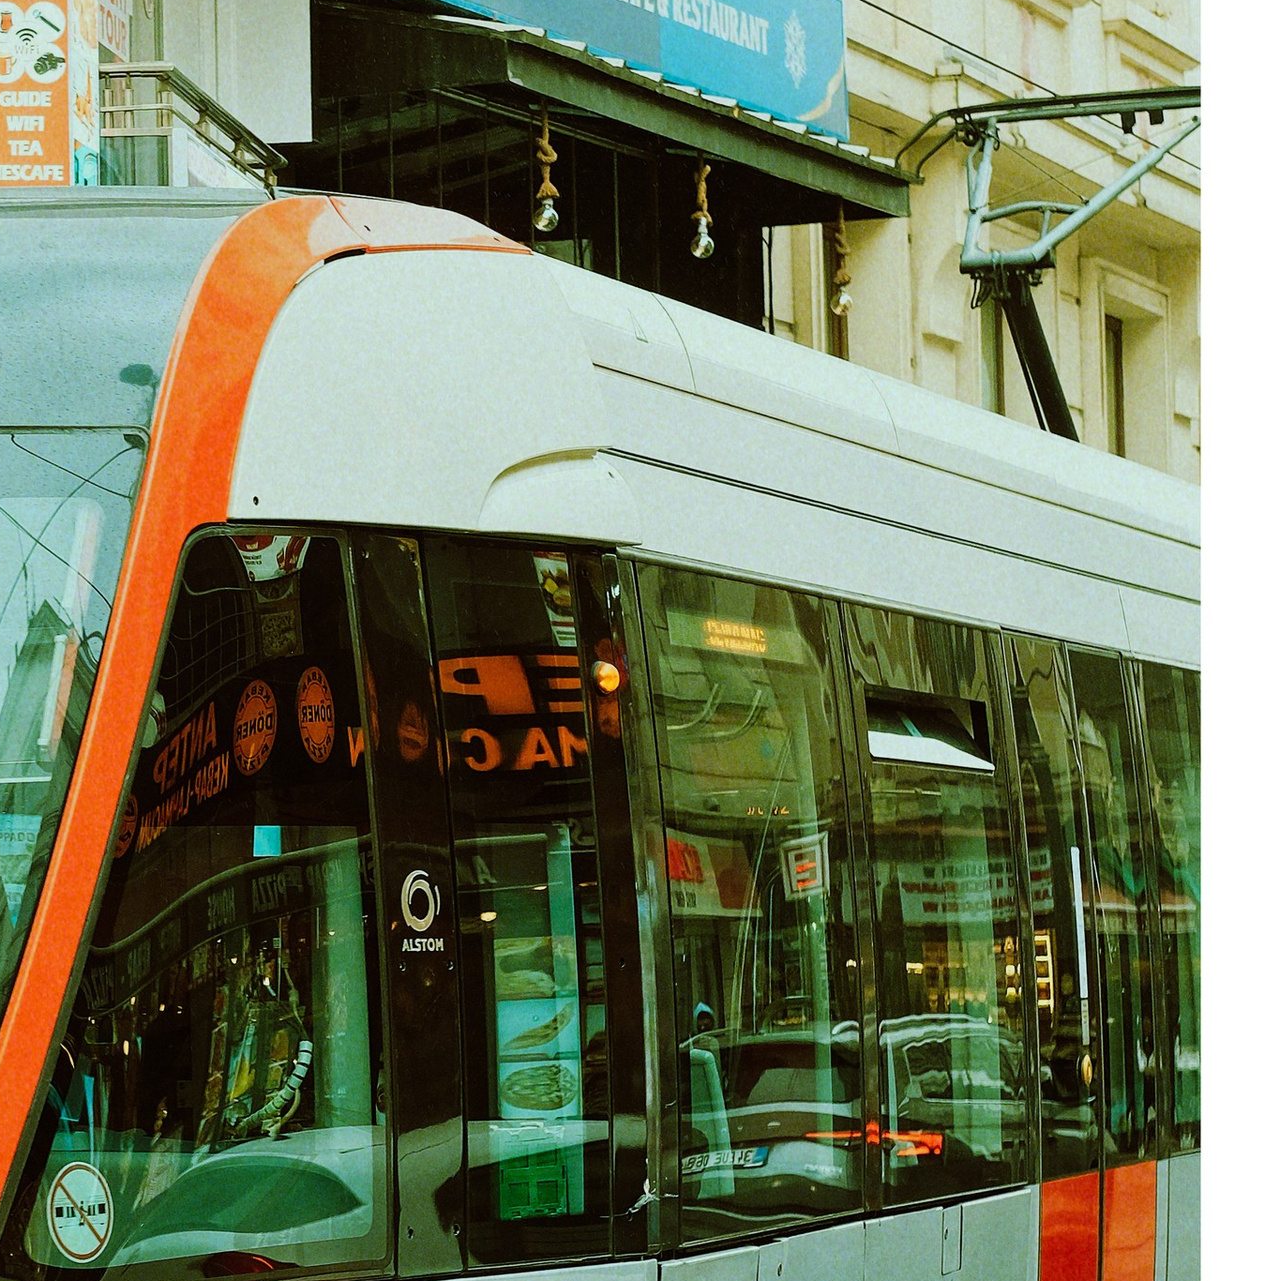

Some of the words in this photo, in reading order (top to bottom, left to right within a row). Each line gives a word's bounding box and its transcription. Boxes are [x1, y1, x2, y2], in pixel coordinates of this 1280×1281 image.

[99, 3, 127, 54] TOUR
[6, 116, 45, 132] WIFI
[8, 140, 43, 156] TEA
[402, 938, 445, 952] ALSTOM
